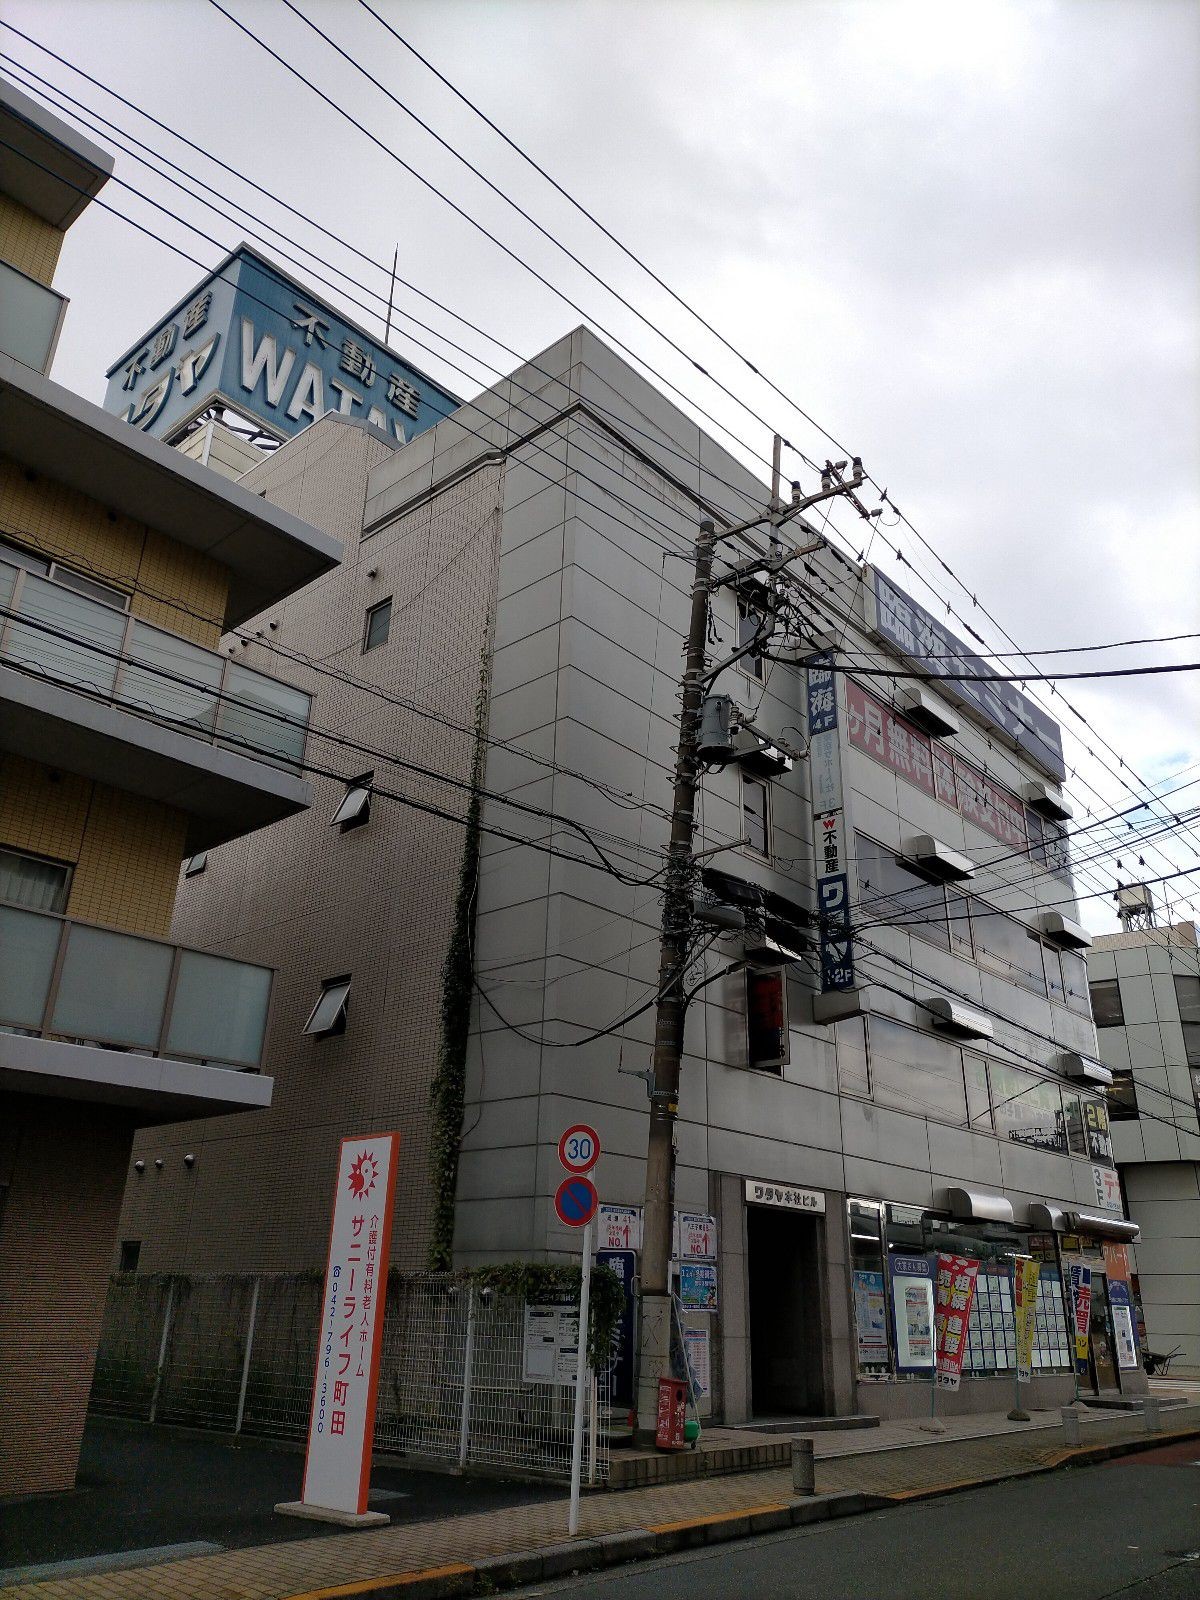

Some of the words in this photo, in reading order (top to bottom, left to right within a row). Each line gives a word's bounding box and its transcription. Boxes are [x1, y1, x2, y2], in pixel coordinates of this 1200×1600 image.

[122, 290, 213, 391] 不動産
[291, 303, 421, 420] 不動産
[119, 332, 221, 432] タヤ
[808, 657, 835, 716] 臨海
[812, 715, 835, 730] 4F
[823, 830, 839, 873] 不動産
[568, 1138, 591, 1160] 30
[754, 1185, 818, 1208] ワタヤ本社ビル
[1094, 1168, 1104, 1206] 3F
[355, 1214, 379, 1378] 介護付有料老人ホーム
[950, 1274, 971, 1311] 相続
[330, 1214, 365, 1437] サニーライフ町田
[317, 1282, 339, 1434] 042-796-3600
